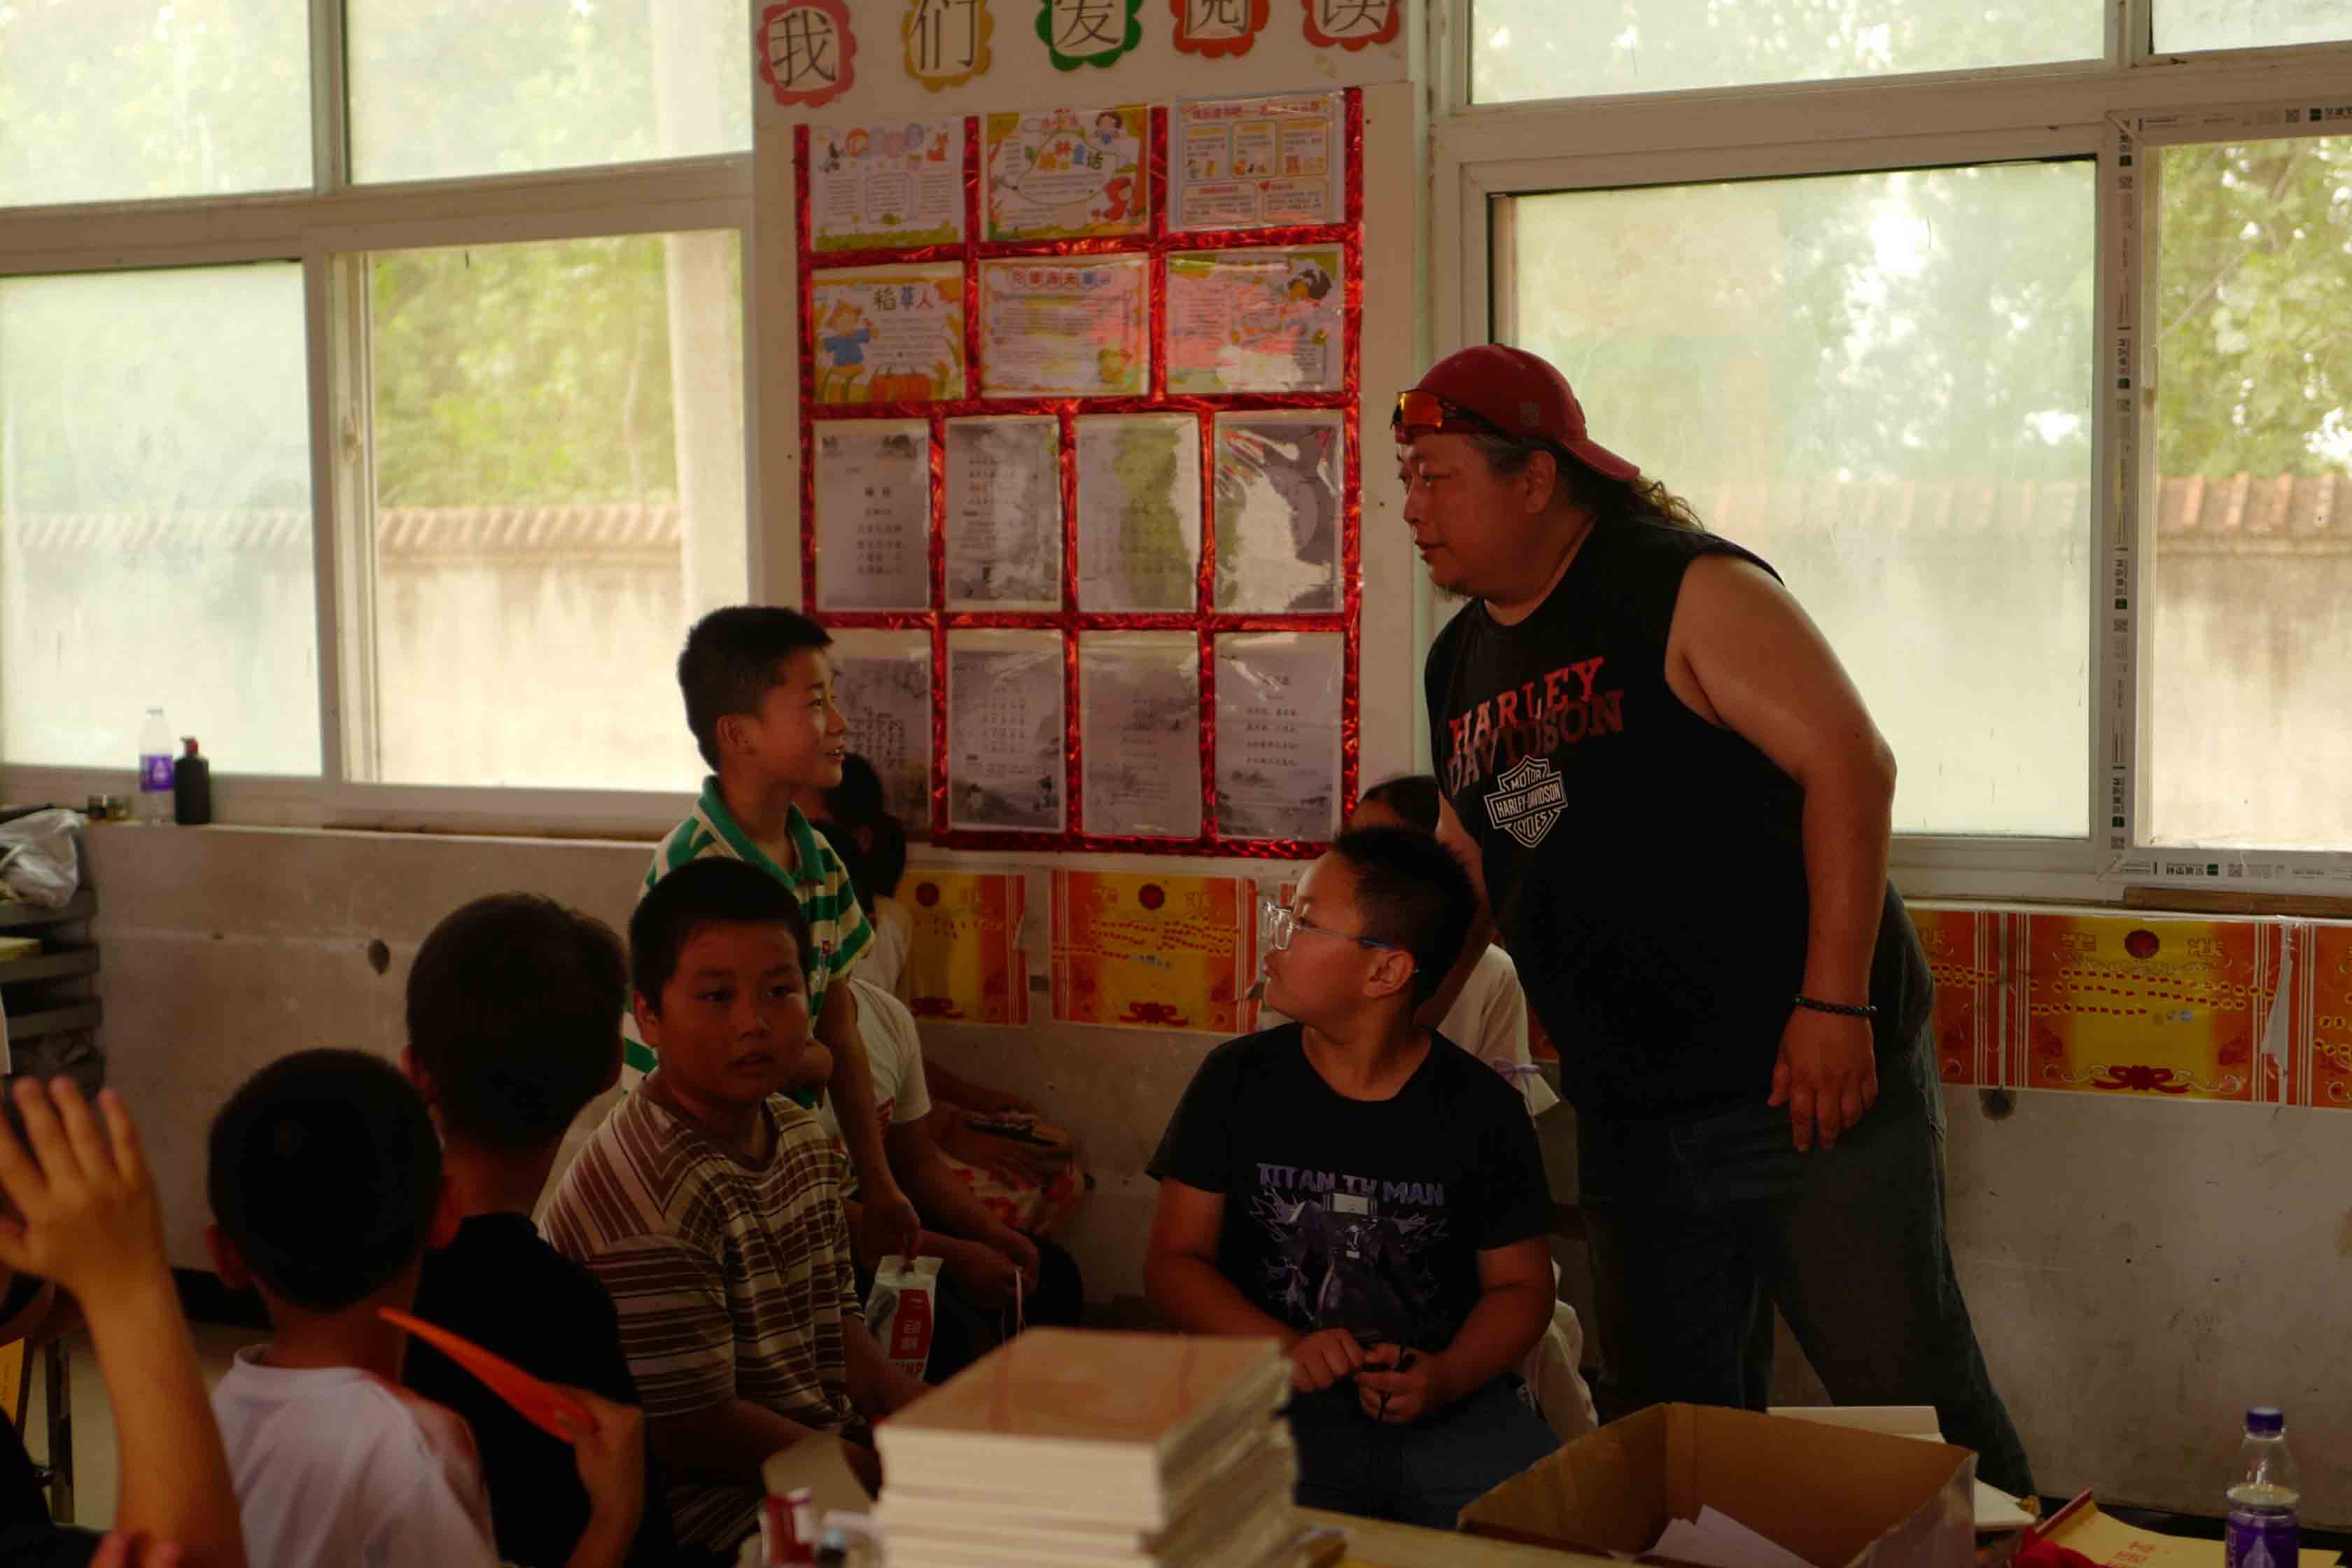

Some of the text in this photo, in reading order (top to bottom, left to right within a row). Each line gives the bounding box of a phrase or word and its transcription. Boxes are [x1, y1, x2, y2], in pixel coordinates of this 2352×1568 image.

[1448, 655, 1606, 756] HARLEY
[1511, 767, 1543, 791] MOTOR
[1516, 811, 1548, 838] CYCLES
[1256, 1162, 1336, 1193] TITAN
[1382, 1180, 1445, 1207] MAN
